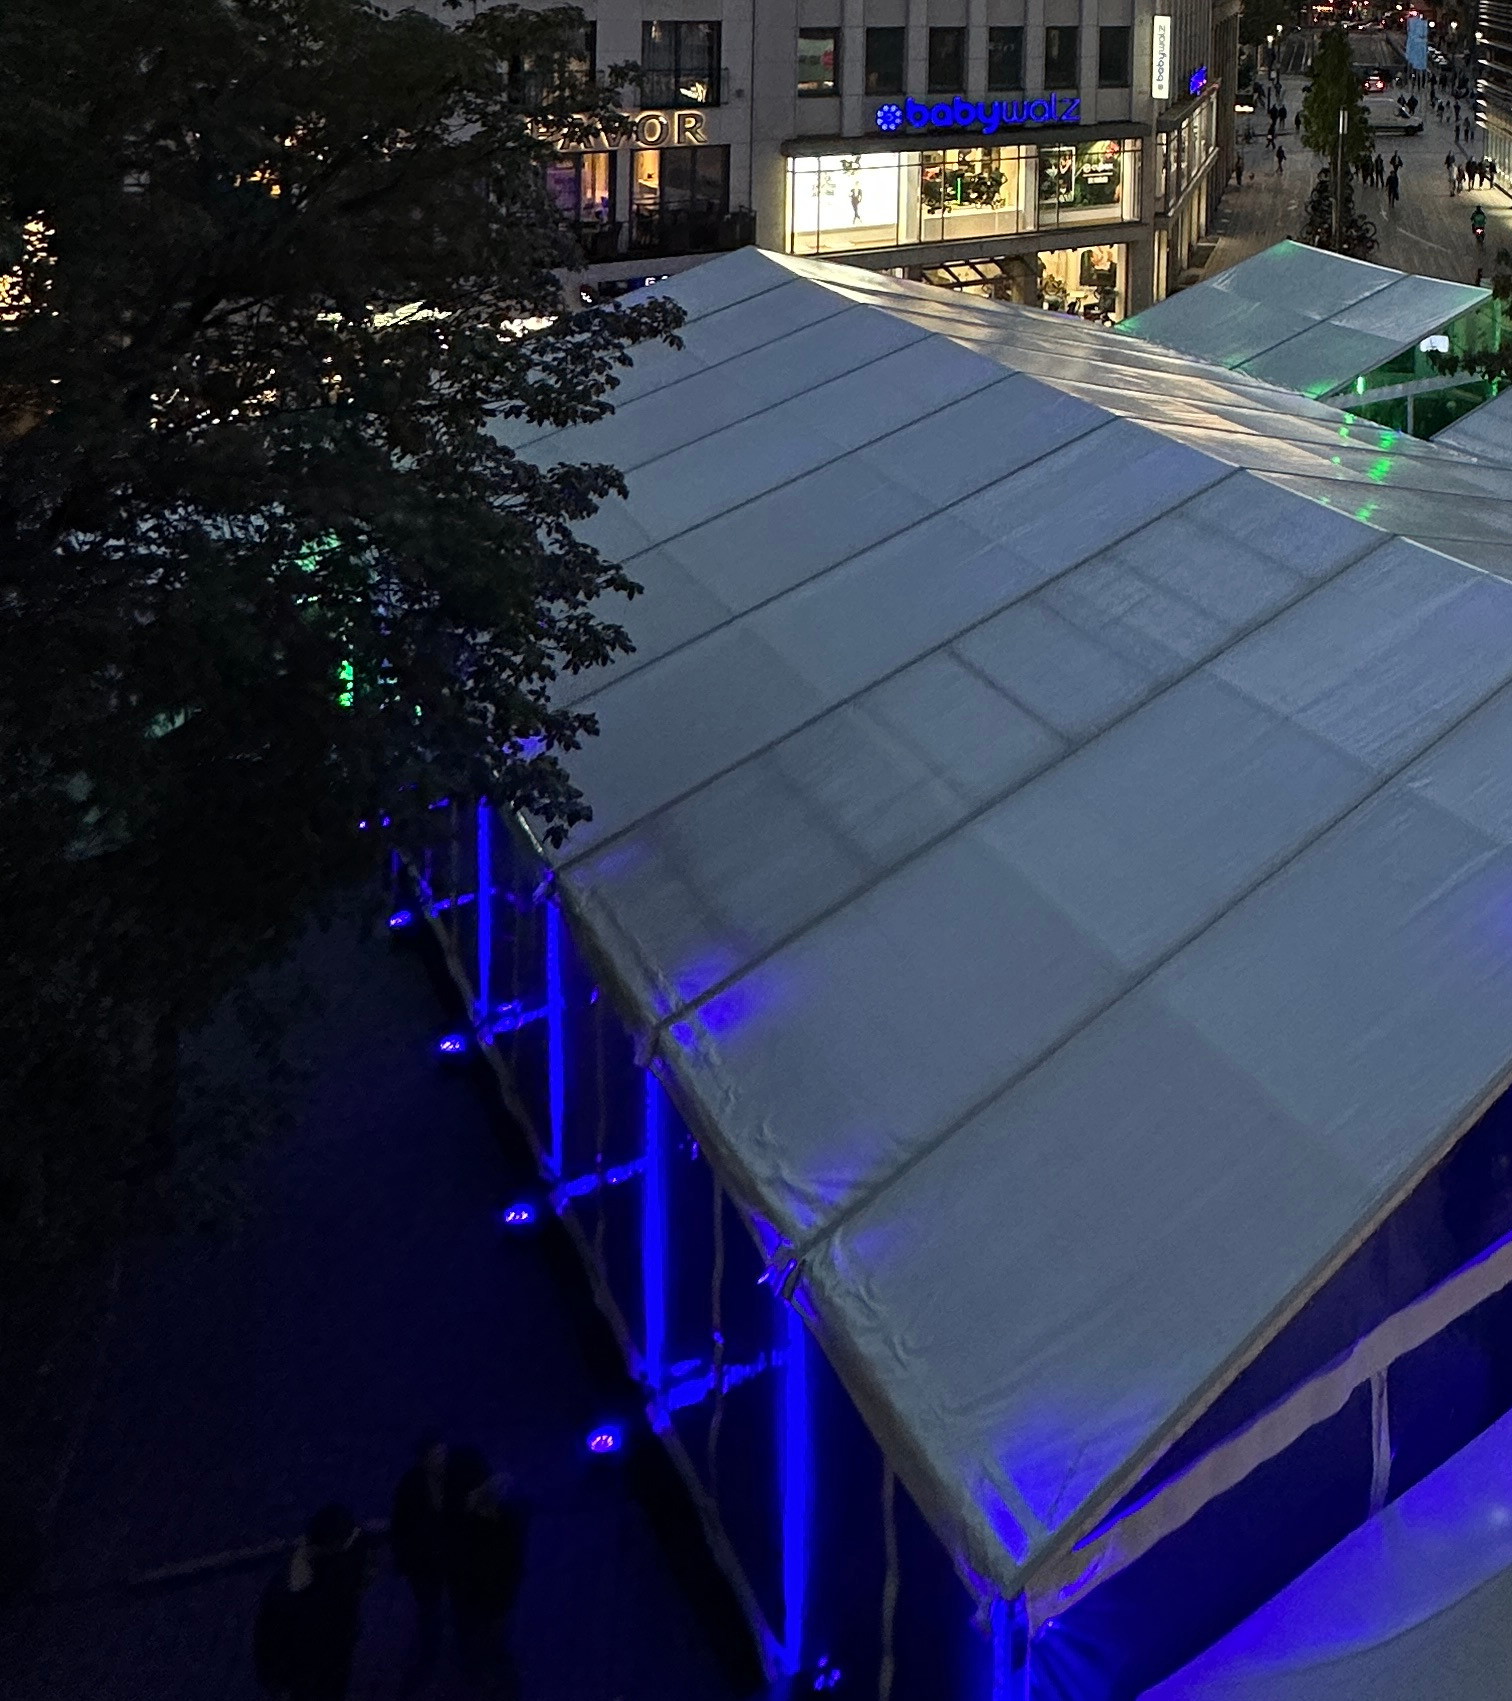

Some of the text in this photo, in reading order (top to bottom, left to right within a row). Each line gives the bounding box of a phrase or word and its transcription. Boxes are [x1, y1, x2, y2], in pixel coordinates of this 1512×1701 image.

[1156, 25, 1167, 82] babywalz
[529, 110, 708, 151] AVOR
[905, 92, 1081, 135] babywalz
